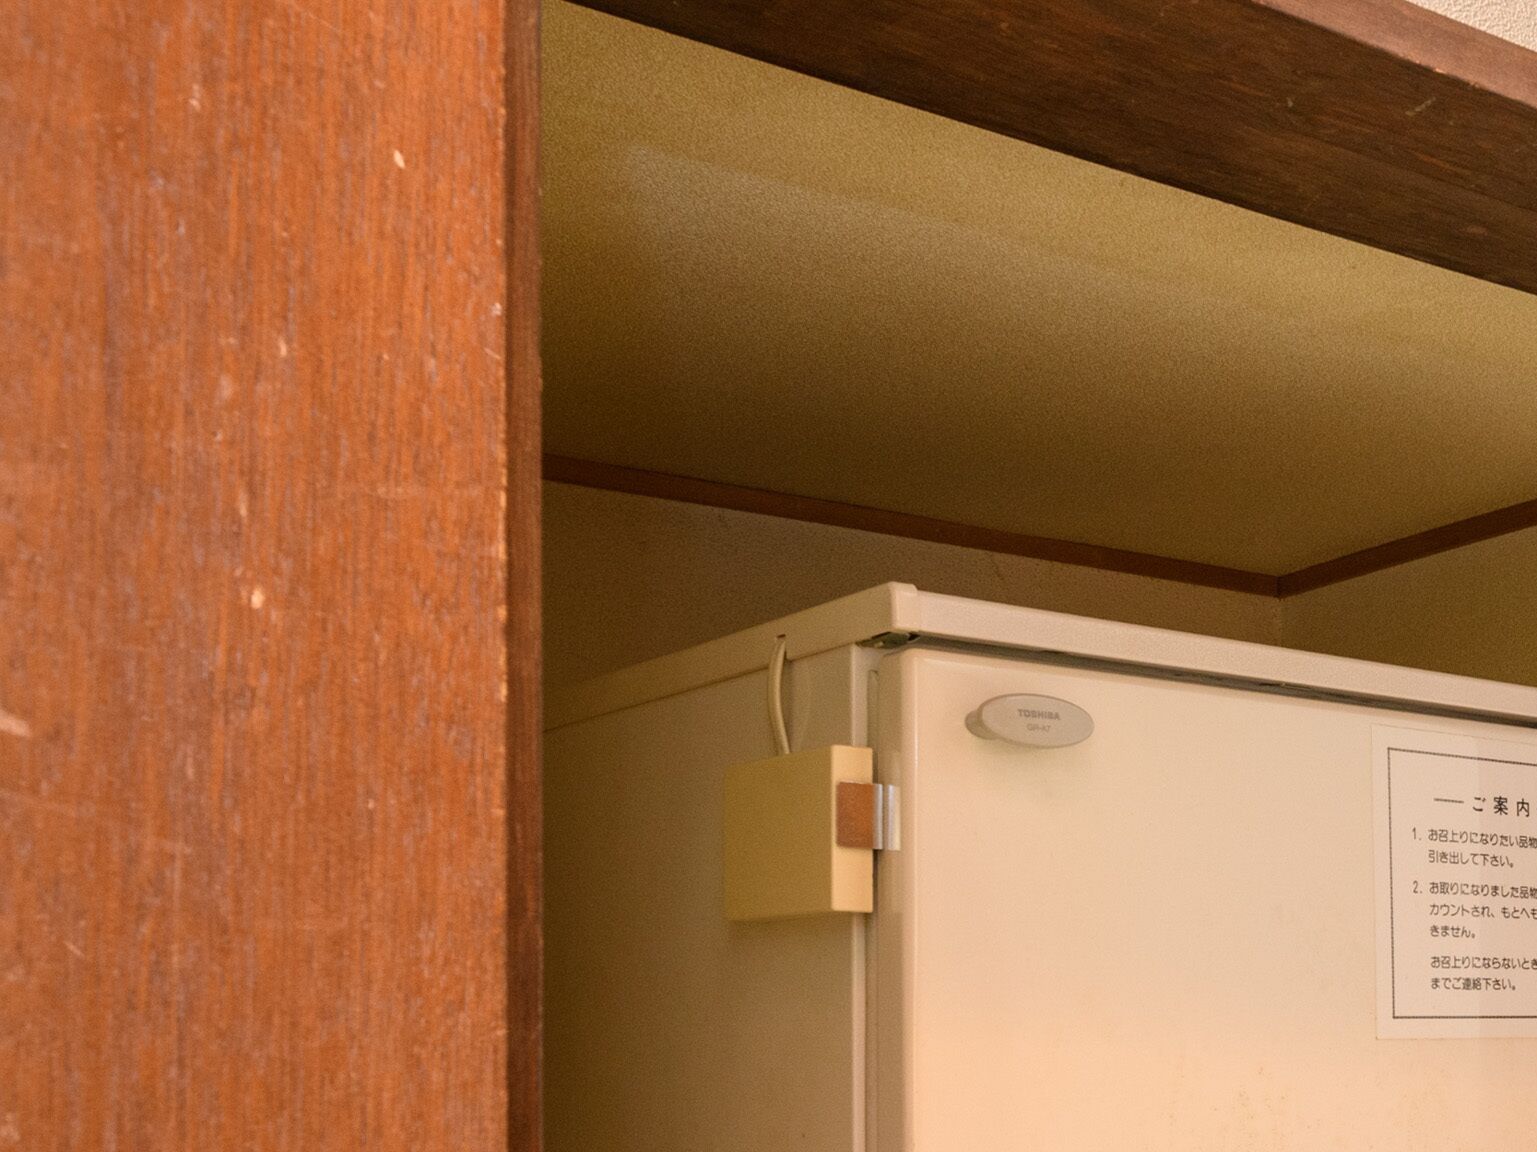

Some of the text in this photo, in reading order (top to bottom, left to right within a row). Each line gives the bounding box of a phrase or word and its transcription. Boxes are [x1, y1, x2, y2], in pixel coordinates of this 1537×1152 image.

[1018, 708, 1061, 721] TOSHIBA
[1428, 849, 1514, 868] 引き出して下さい。
[1429, 925, 1476, 939] きません。
[1431, 977, 1517, 992] までご連絡下さい。
